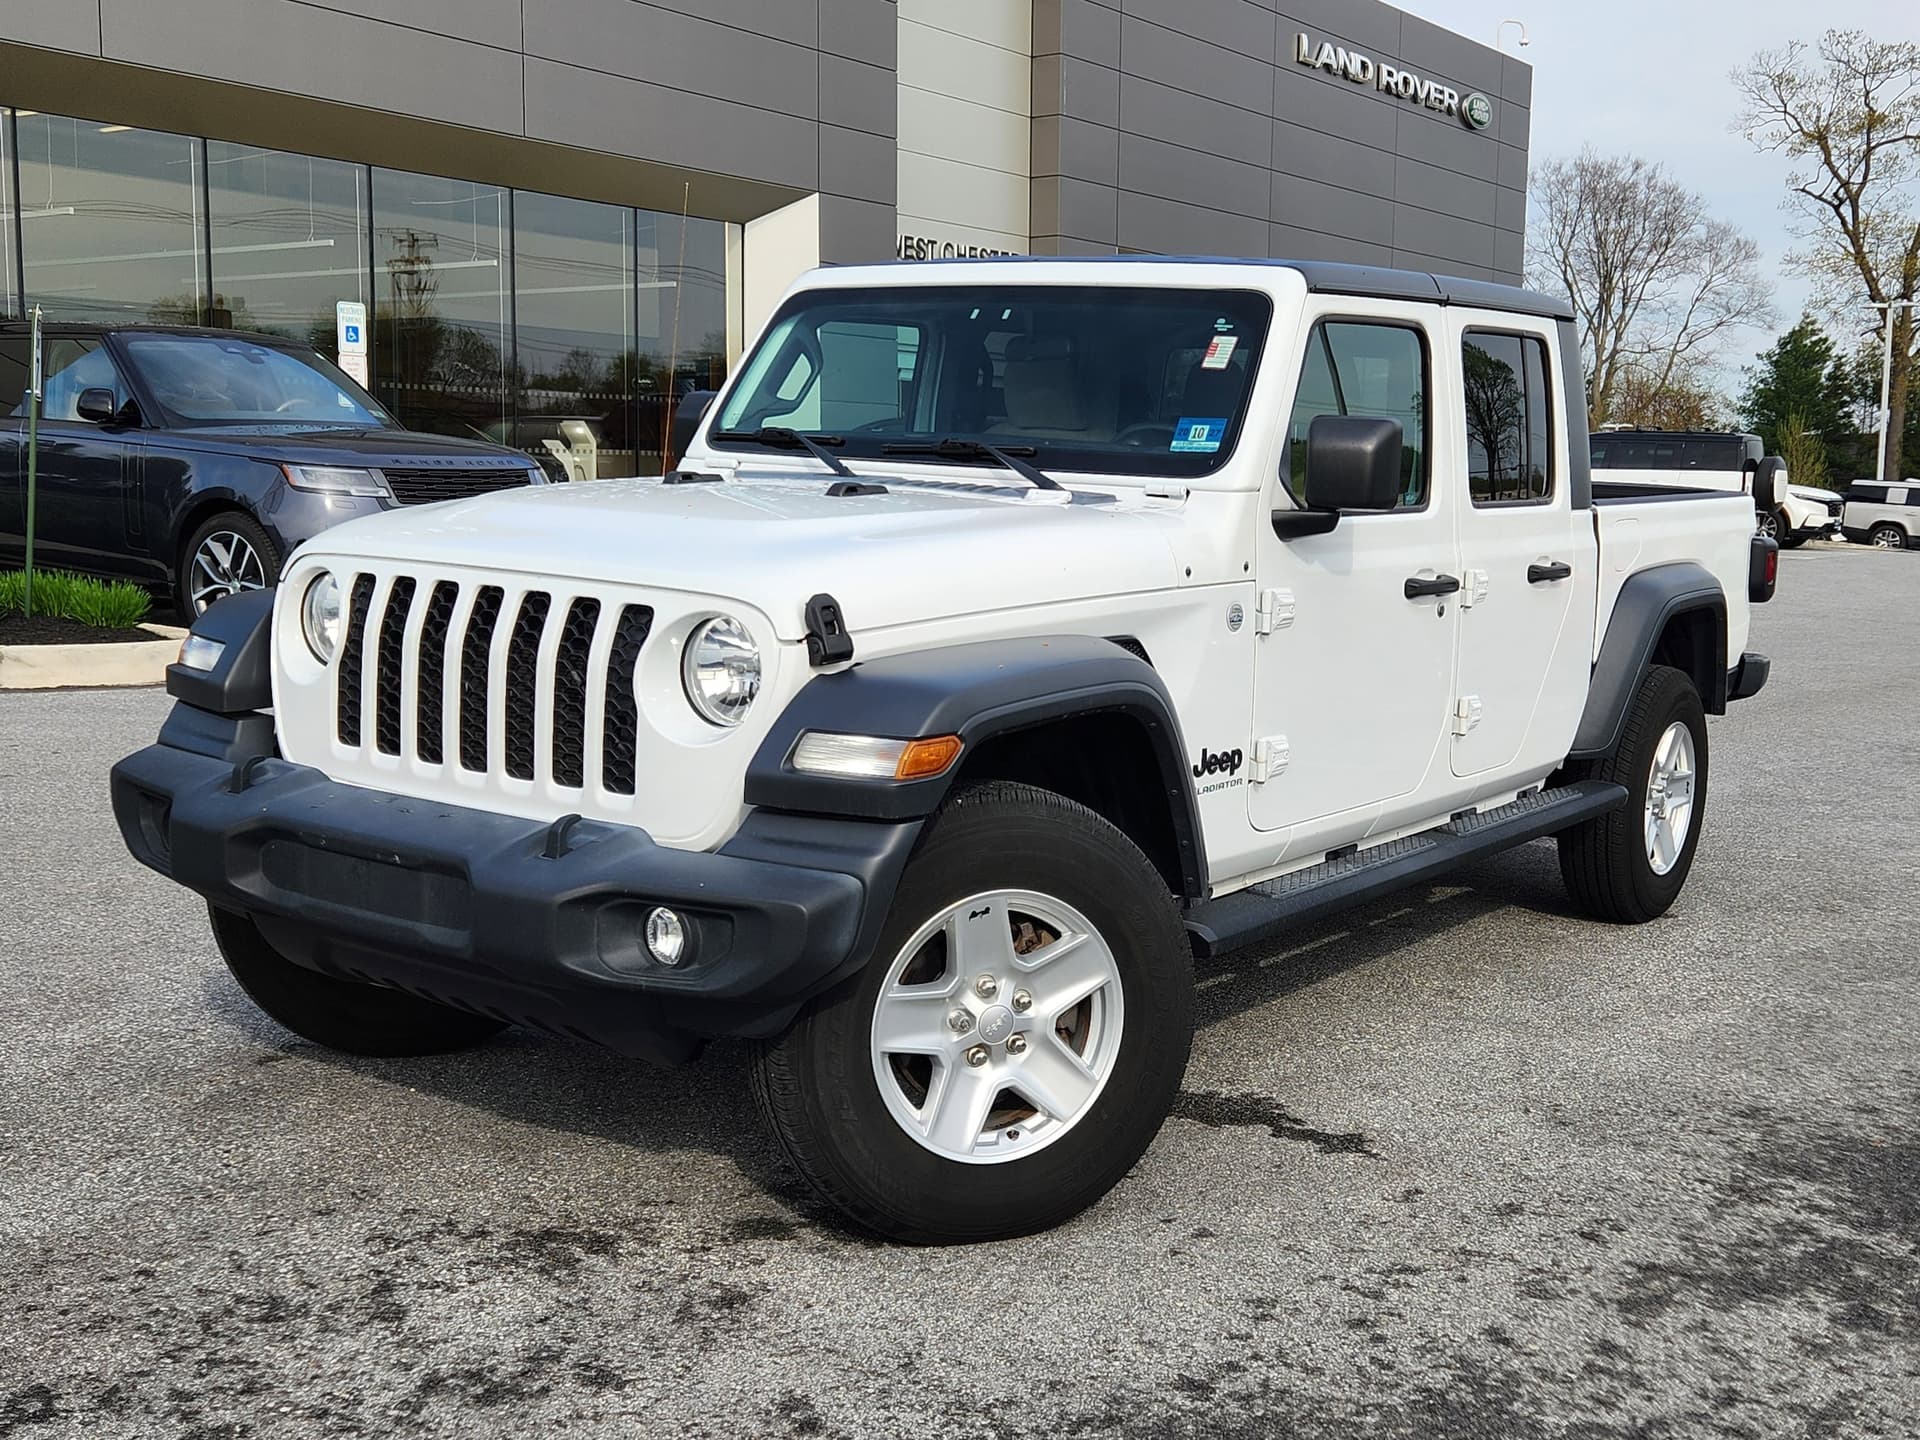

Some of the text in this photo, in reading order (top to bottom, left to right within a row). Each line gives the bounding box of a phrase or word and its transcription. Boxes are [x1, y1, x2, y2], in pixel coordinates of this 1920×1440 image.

[1296, 32, 1460, 115] LAND ROVER
[897, 234, 938, 261] EST
[1191, 426, 1205, 439] 10
[1193, 748, 1243, 778] Jeep
[1197, 778, 1243, 796] LADIATOR
